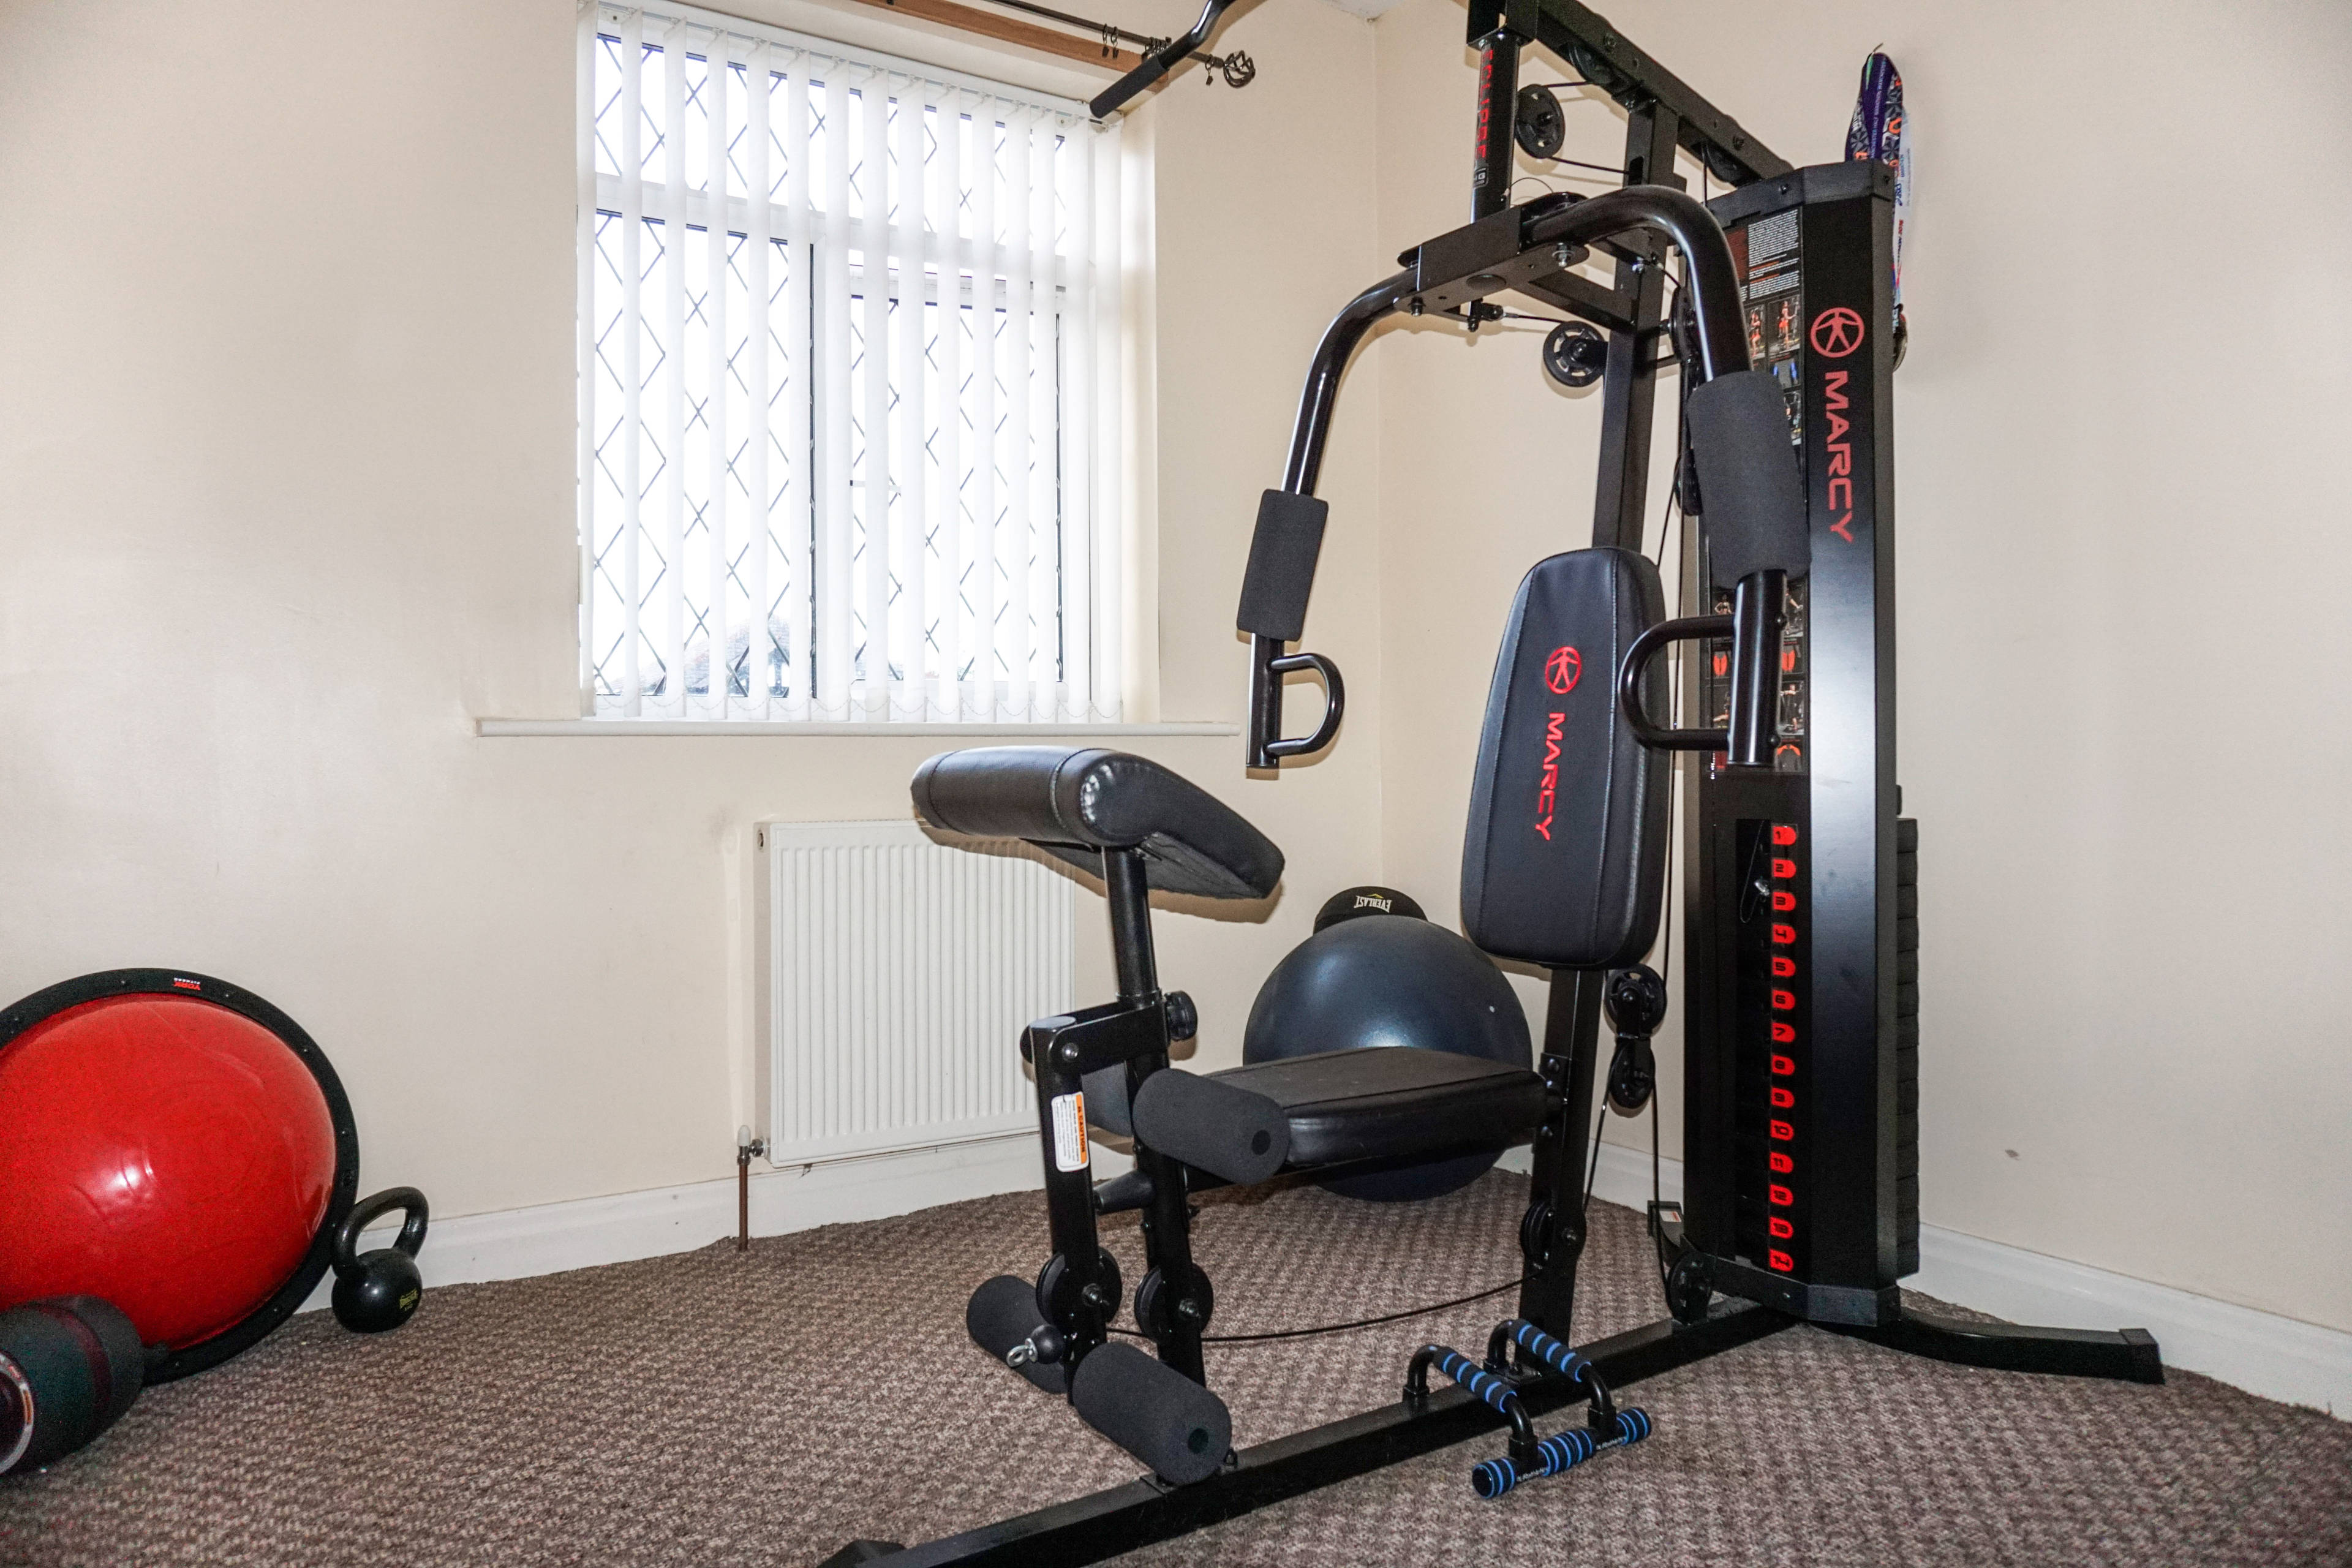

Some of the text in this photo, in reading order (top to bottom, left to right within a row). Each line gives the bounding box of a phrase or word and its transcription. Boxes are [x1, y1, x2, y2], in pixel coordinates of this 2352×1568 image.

[1476, 49, 1493, 158] ECLIPSE
[1824, 370, 1855, 543] MARCY
[1535, 712, 1566, 841] MARCY
[1776, 831, 1781, 840] 1
[1776, 864, 1784, 873] 2
[1354, 895, 1392, 913] EVERLAST
[1776, 896, 1786, 906] 3
[1776, 929, 1787, 940] 4
[1776, 962, 1786, 971] 5
[173, 981, 202, 990] YORK
[1775, 995, 1786, 1005] 6
[1775, 1027, 1785, 1036] 7
[1774, 1125, 1789, 1136] 10
[1774, 1158, 1784, 1168] 11
